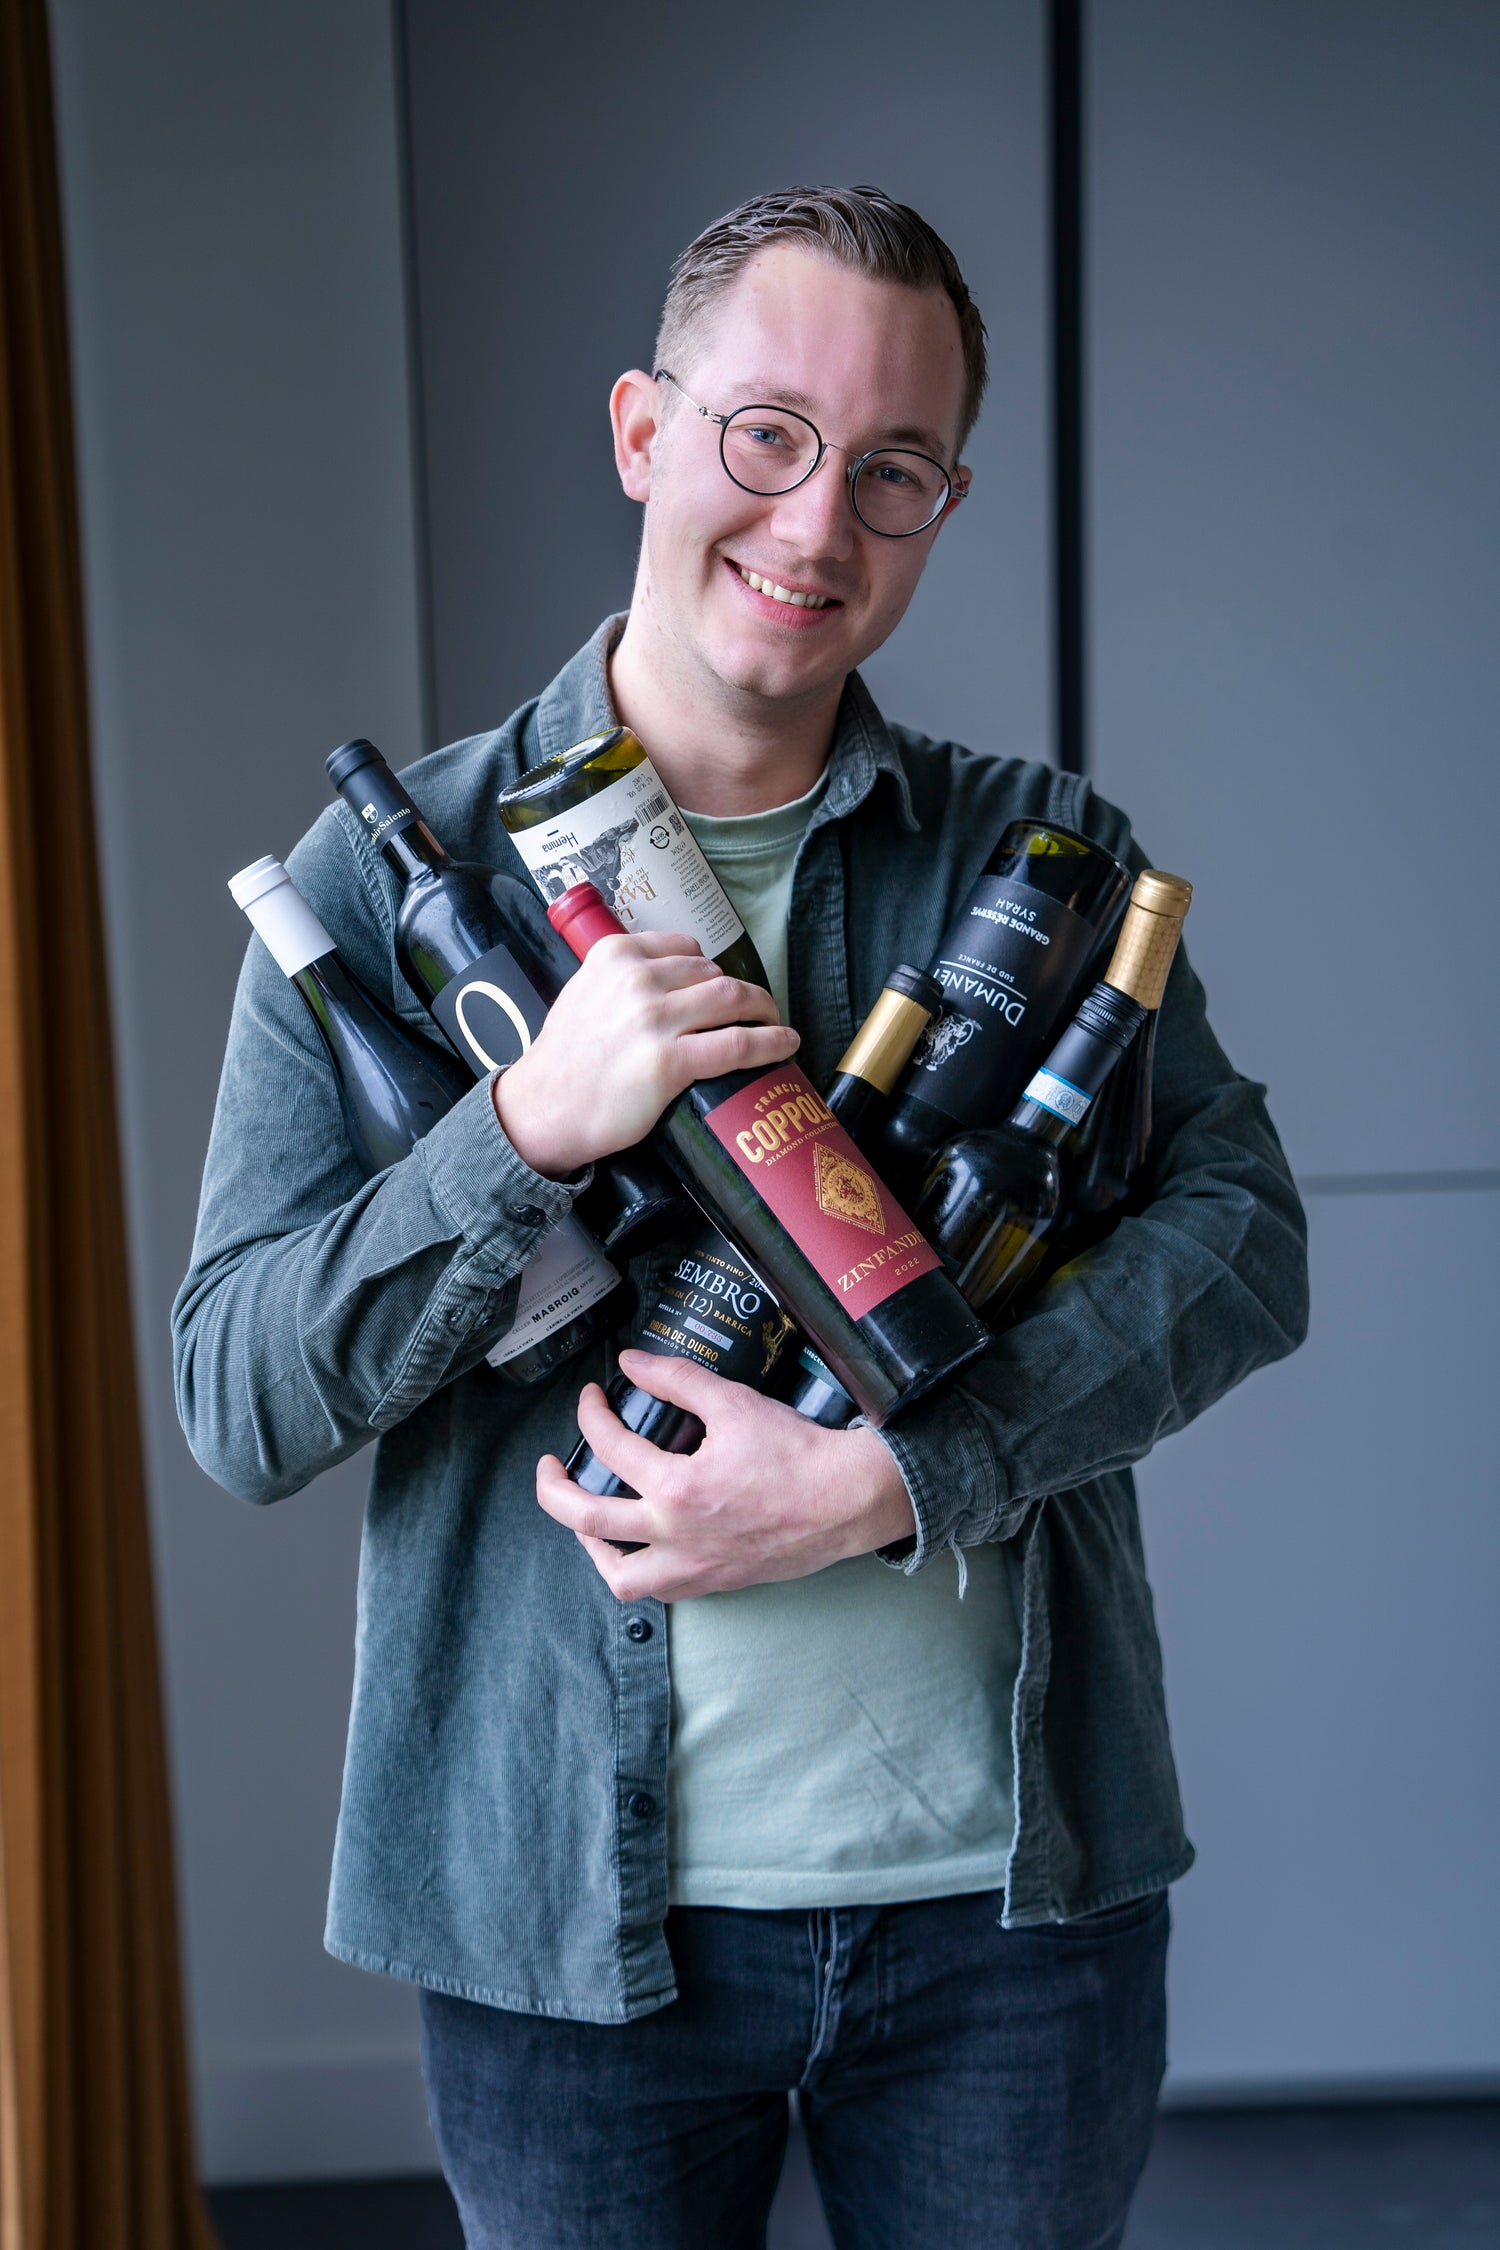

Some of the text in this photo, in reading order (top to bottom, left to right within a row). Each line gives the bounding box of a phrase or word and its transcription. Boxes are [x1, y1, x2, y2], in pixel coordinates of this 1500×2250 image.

[541, 830, 579, 859] Hemina
[970, 905, 1051, 946] GRANDE RÉSERVE
[994, 897, 1037, 921] SYRAH
[957, 953, 1015, 983] SUD DE FRANCE
[754, 1084, 801, 1112] FRANCIS
[734, 1089, 832, 1164] COPPOL
[764, 1120, 837, 1166] DIAMOND COLLECTI
[704, 1253, 725, 1267] TINTO
[725, 1263, 744, 1277] FINO
[748, 1277, 769, 1293] 202
[836, 1229, 926, 1292] ZINFANDE
[894, 1257, 920, 1276] 2022
[673, 1258, 759, 1319] SEMBRO
[511, 1319, 531, 1335] CELLER
[531, 1286, 580, 1322] MASROIG
[681, 1288, 715, 1319] (12)
[712, 1309, 754, 1337] BARRICA
[648, 1318, 719, 1362] RIBERA DEL DUERO
[693, 1322, 723, 1343] 00.733
[680, 1348, 690, 1356] DE
[691, 1354, 719, 1371] ORIGEN
